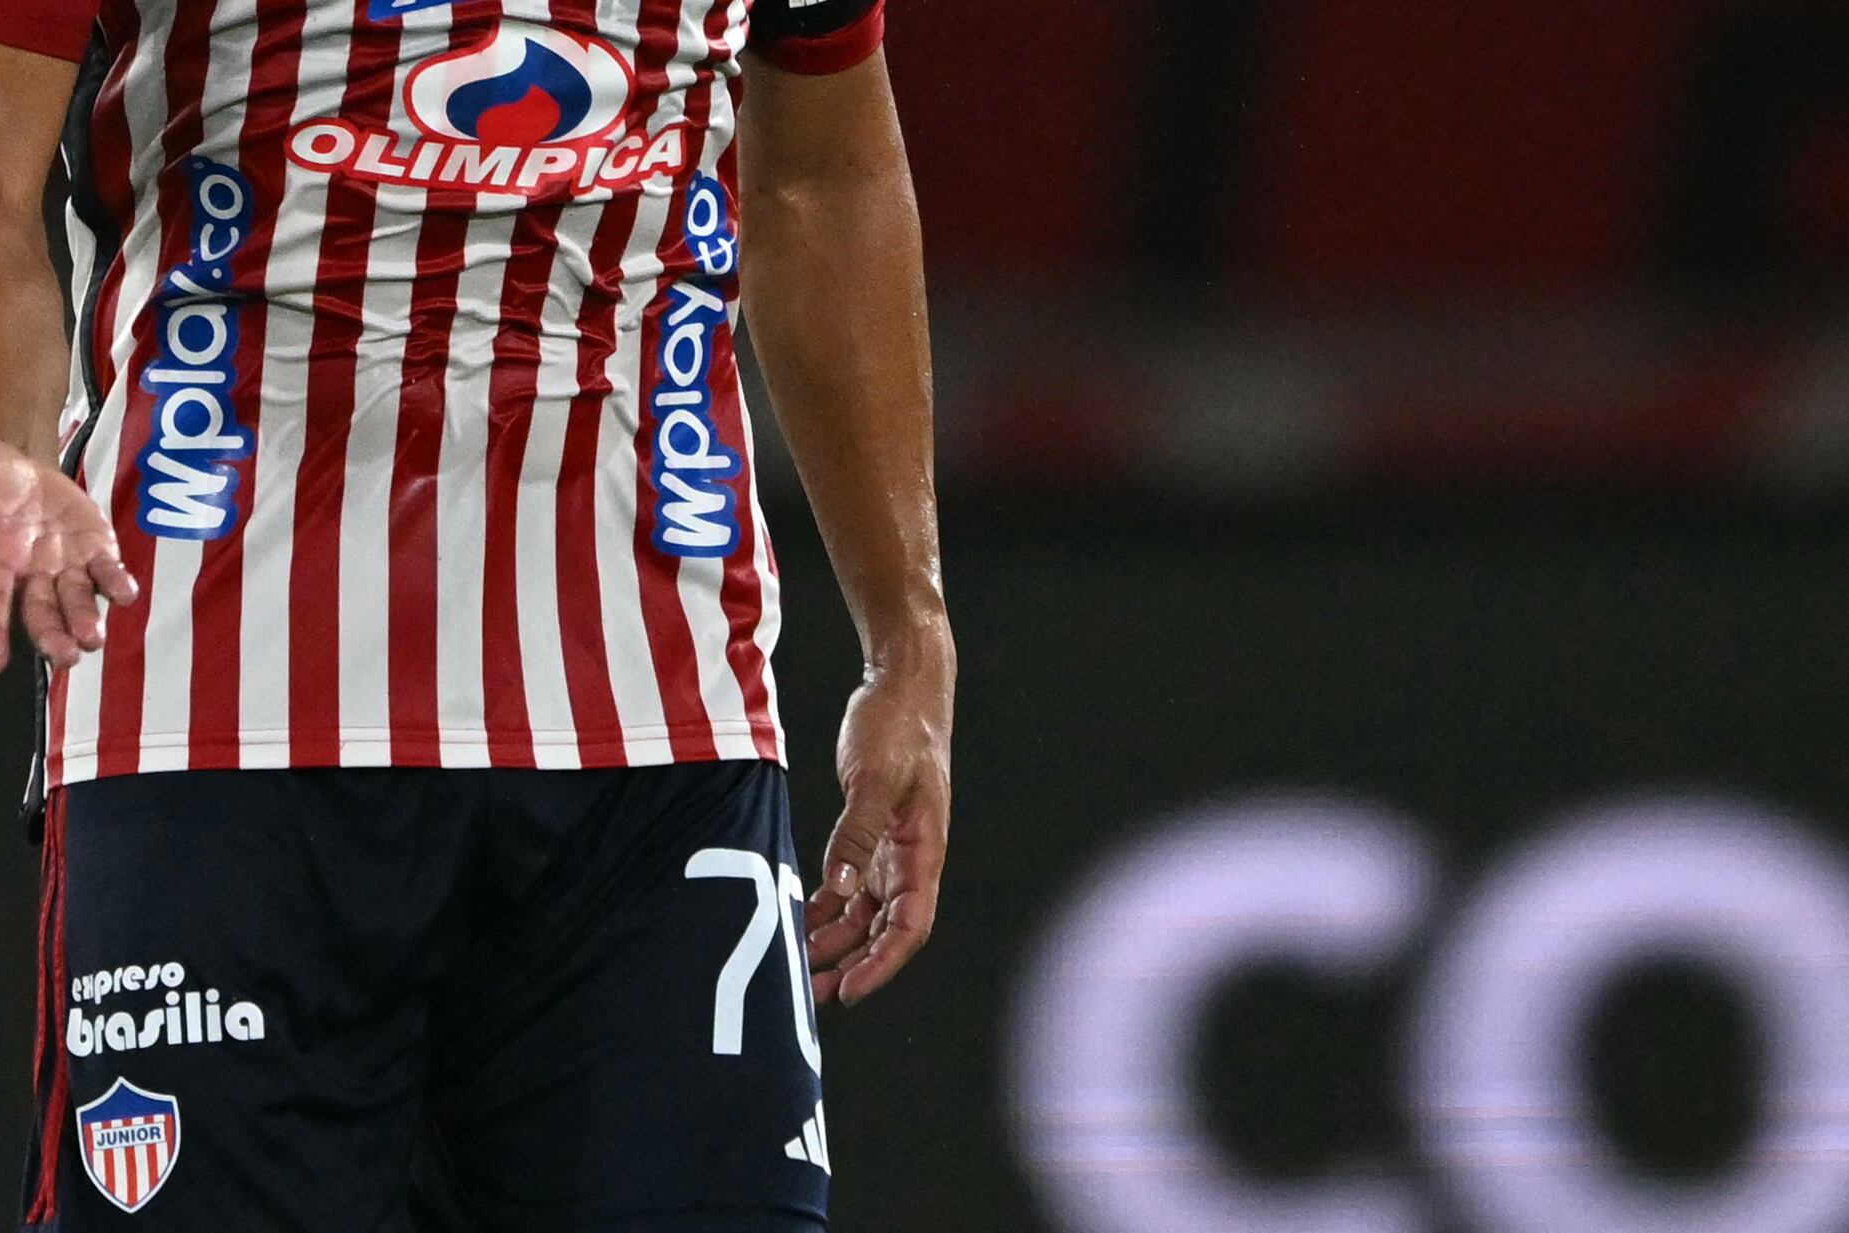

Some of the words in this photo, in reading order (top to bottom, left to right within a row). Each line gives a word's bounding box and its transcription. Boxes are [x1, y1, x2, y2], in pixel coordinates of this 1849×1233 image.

[291, 123, 685, 188] OLIMPICA
[654, 188, 738, 547] Wplayco
[72, 962, 185, 1005] expreso
[66, 988, 266, 1058] brasilia
[96, 1126, 163, 1147] JUNIOR
